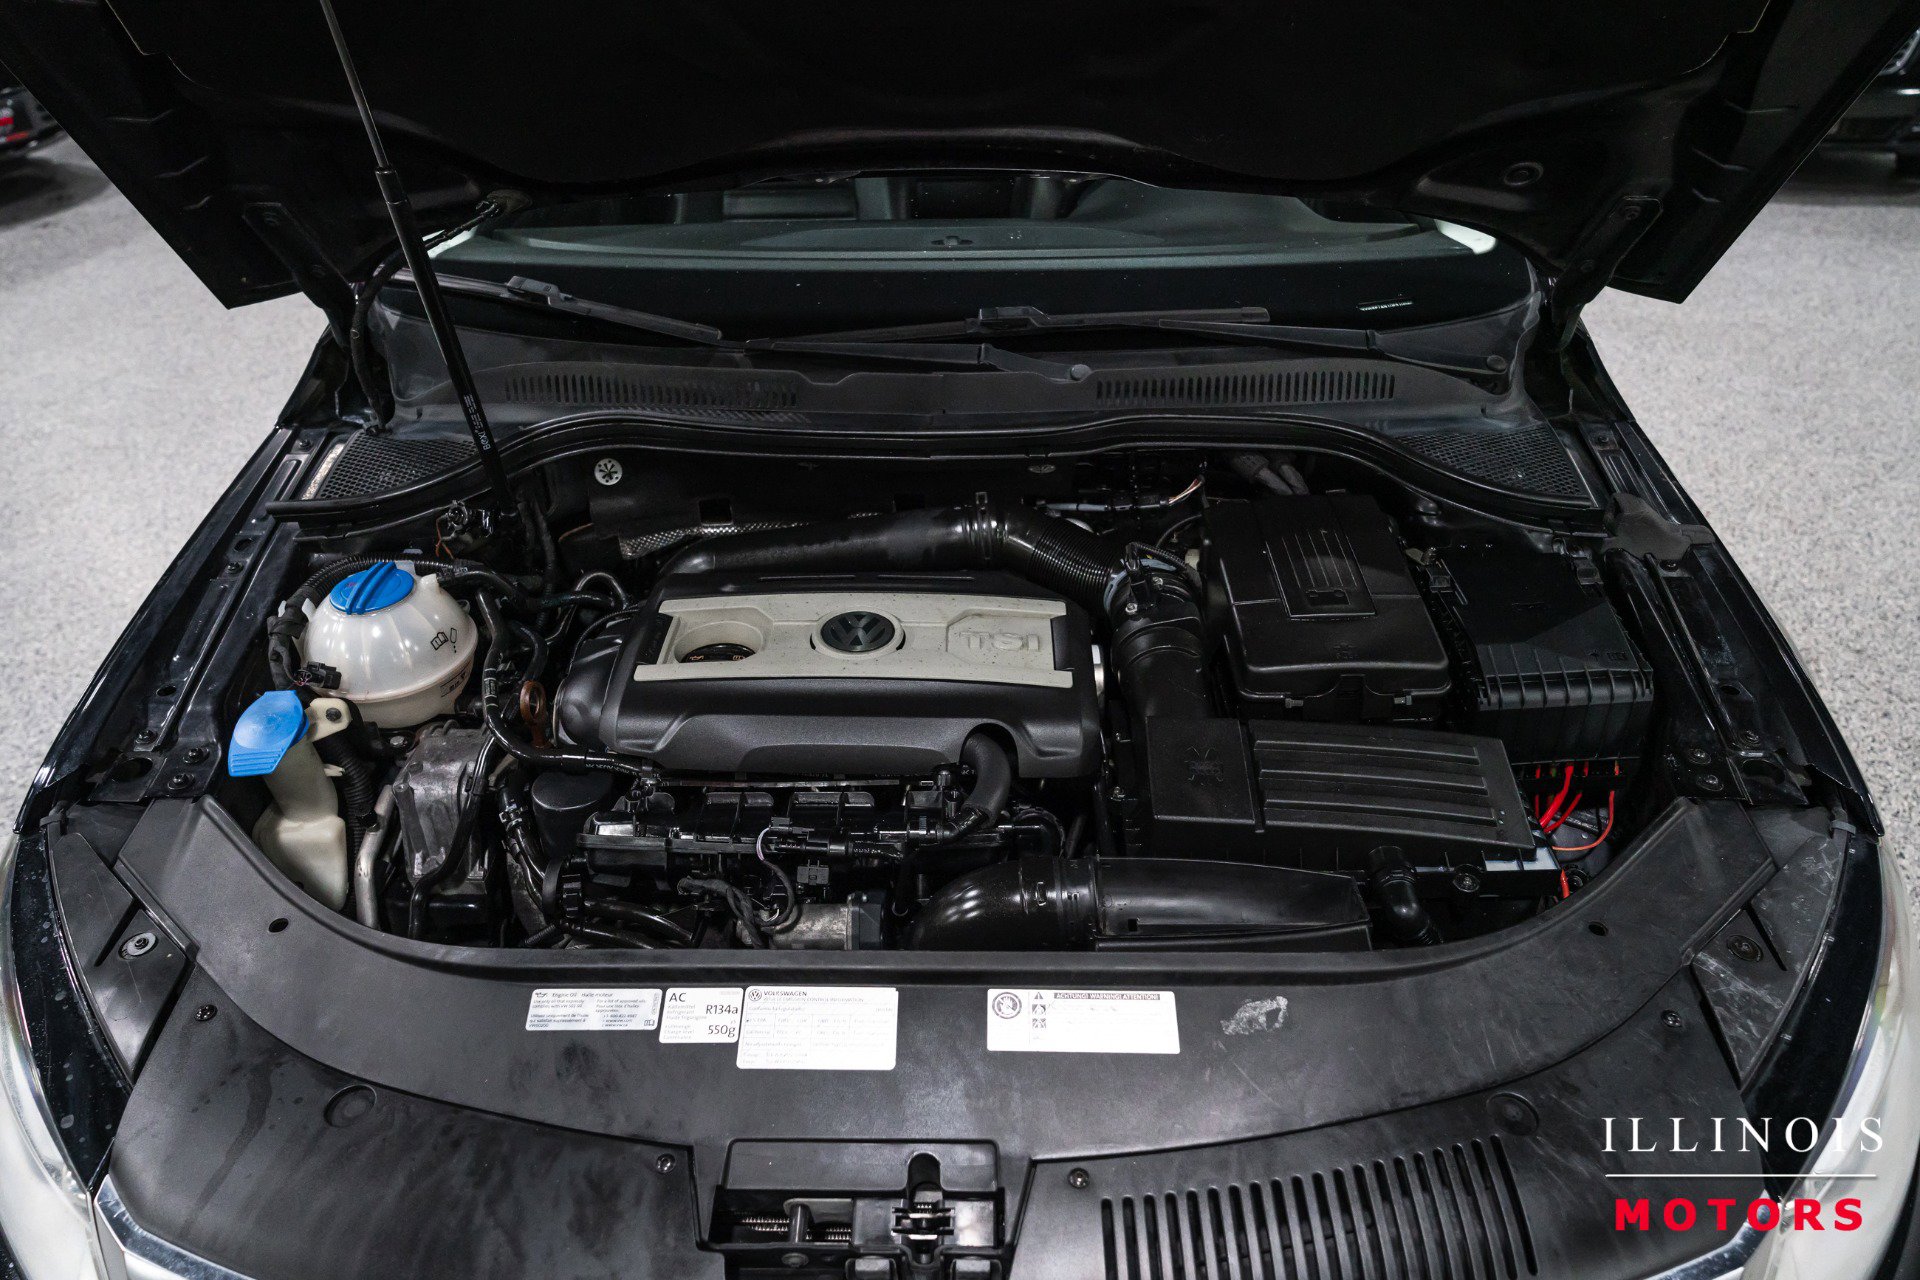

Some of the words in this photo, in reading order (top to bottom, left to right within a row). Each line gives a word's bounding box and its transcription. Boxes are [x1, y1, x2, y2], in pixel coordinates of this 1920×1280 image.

[959, 631, 1040, 651] TSI
[668, 992, 687, 1003] AC
[705, 1004, 739, 1015] R134a
[707, 1024, 736, 1038] 550g
